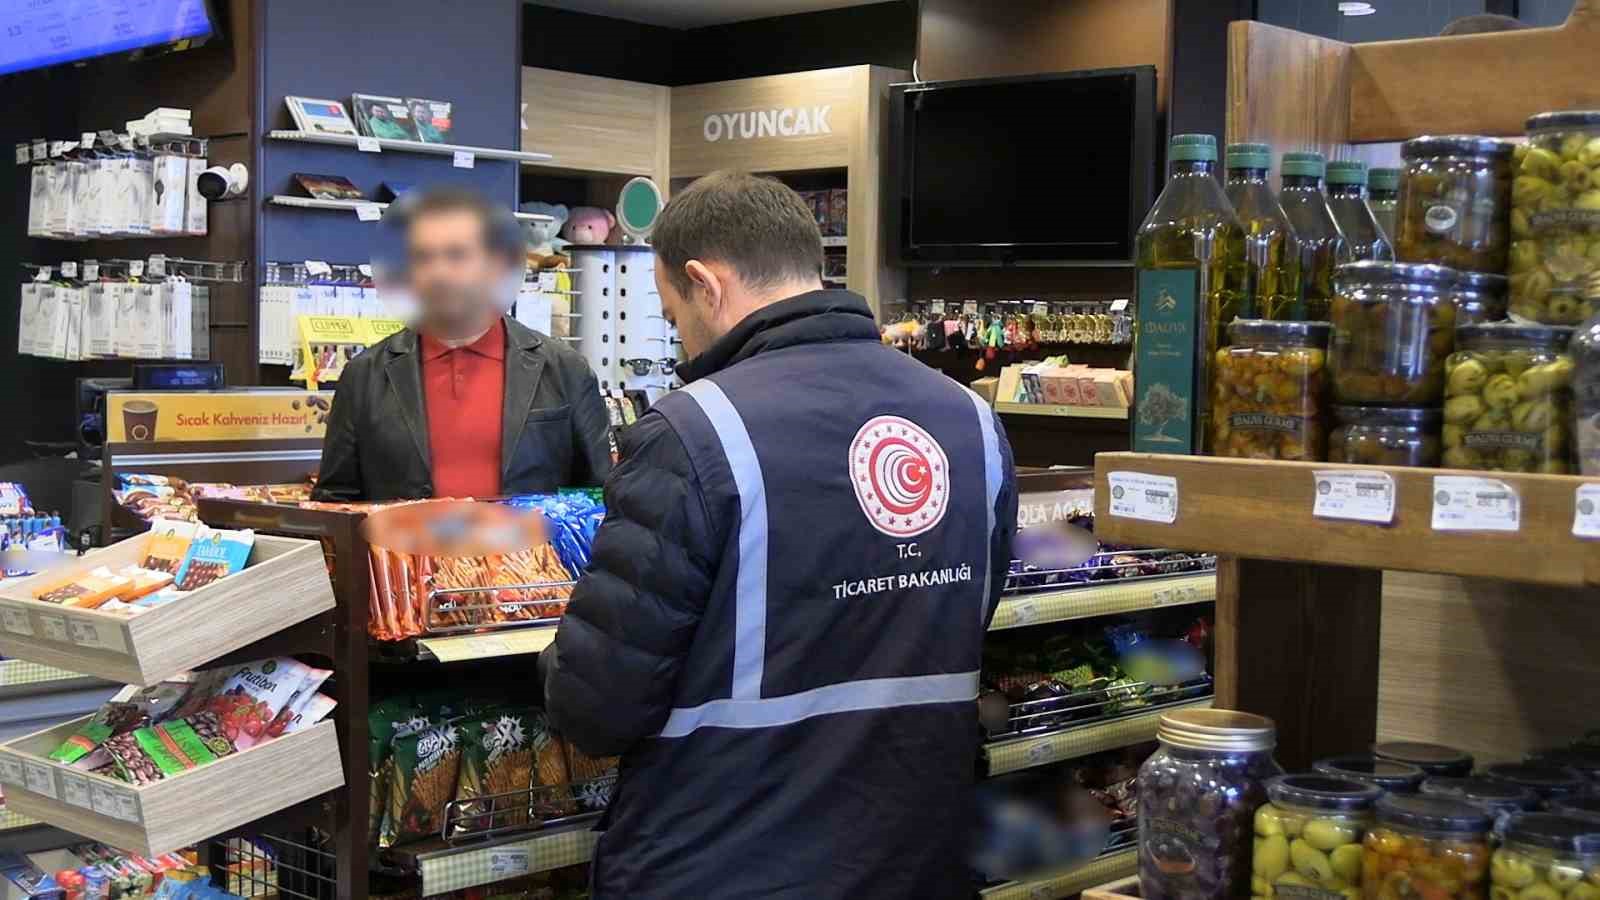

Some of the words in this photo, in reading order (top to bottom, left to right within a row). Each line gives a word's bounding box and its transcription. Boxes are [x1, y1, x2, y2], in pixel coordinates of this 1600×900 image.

[703, 104, 832, 142] OYUNCAK
[176, 411, 209, 426] Sıcak
[213, 411, 269, 425] Kahveniz
[272, 412, 307, 425] Hazır!
[896, 543, 922, 559] T.C.
[833, 576, 895, 599] TİCARET
[898, 563, 972, 589] BAKANLIĞI
